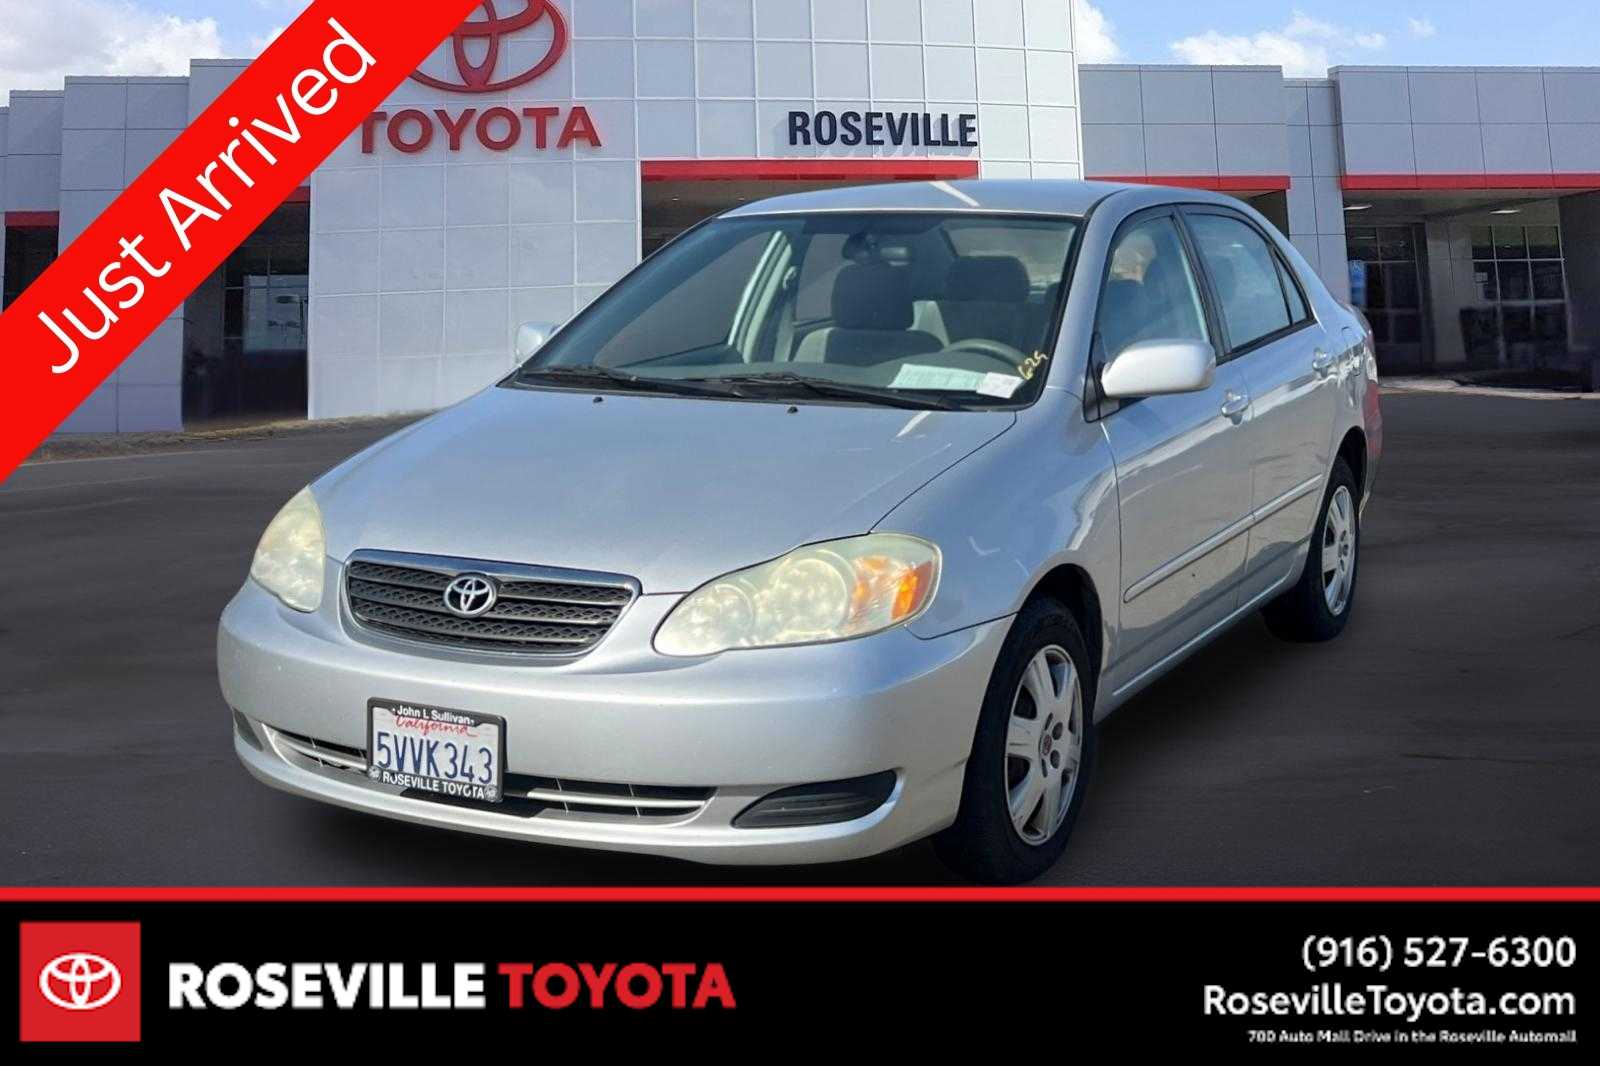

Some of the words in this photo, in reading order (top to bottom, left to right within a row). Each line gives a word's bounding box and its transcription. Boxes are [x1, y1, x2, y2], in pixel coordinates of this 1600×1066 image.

[361, 106, 602, 154] TOYOTA
[788, 110, 978, 147] ROSEVILLE
[397, 705, 421, 718] John
[423, 710, 430, 719] L
[431, 710, 471, 725] Sullivan
[377, 731, 493, 785] 5VVK343
[382, 771, 440, 792] ROSEVILLE
[442, 781, 485, 799] TOYOTA
